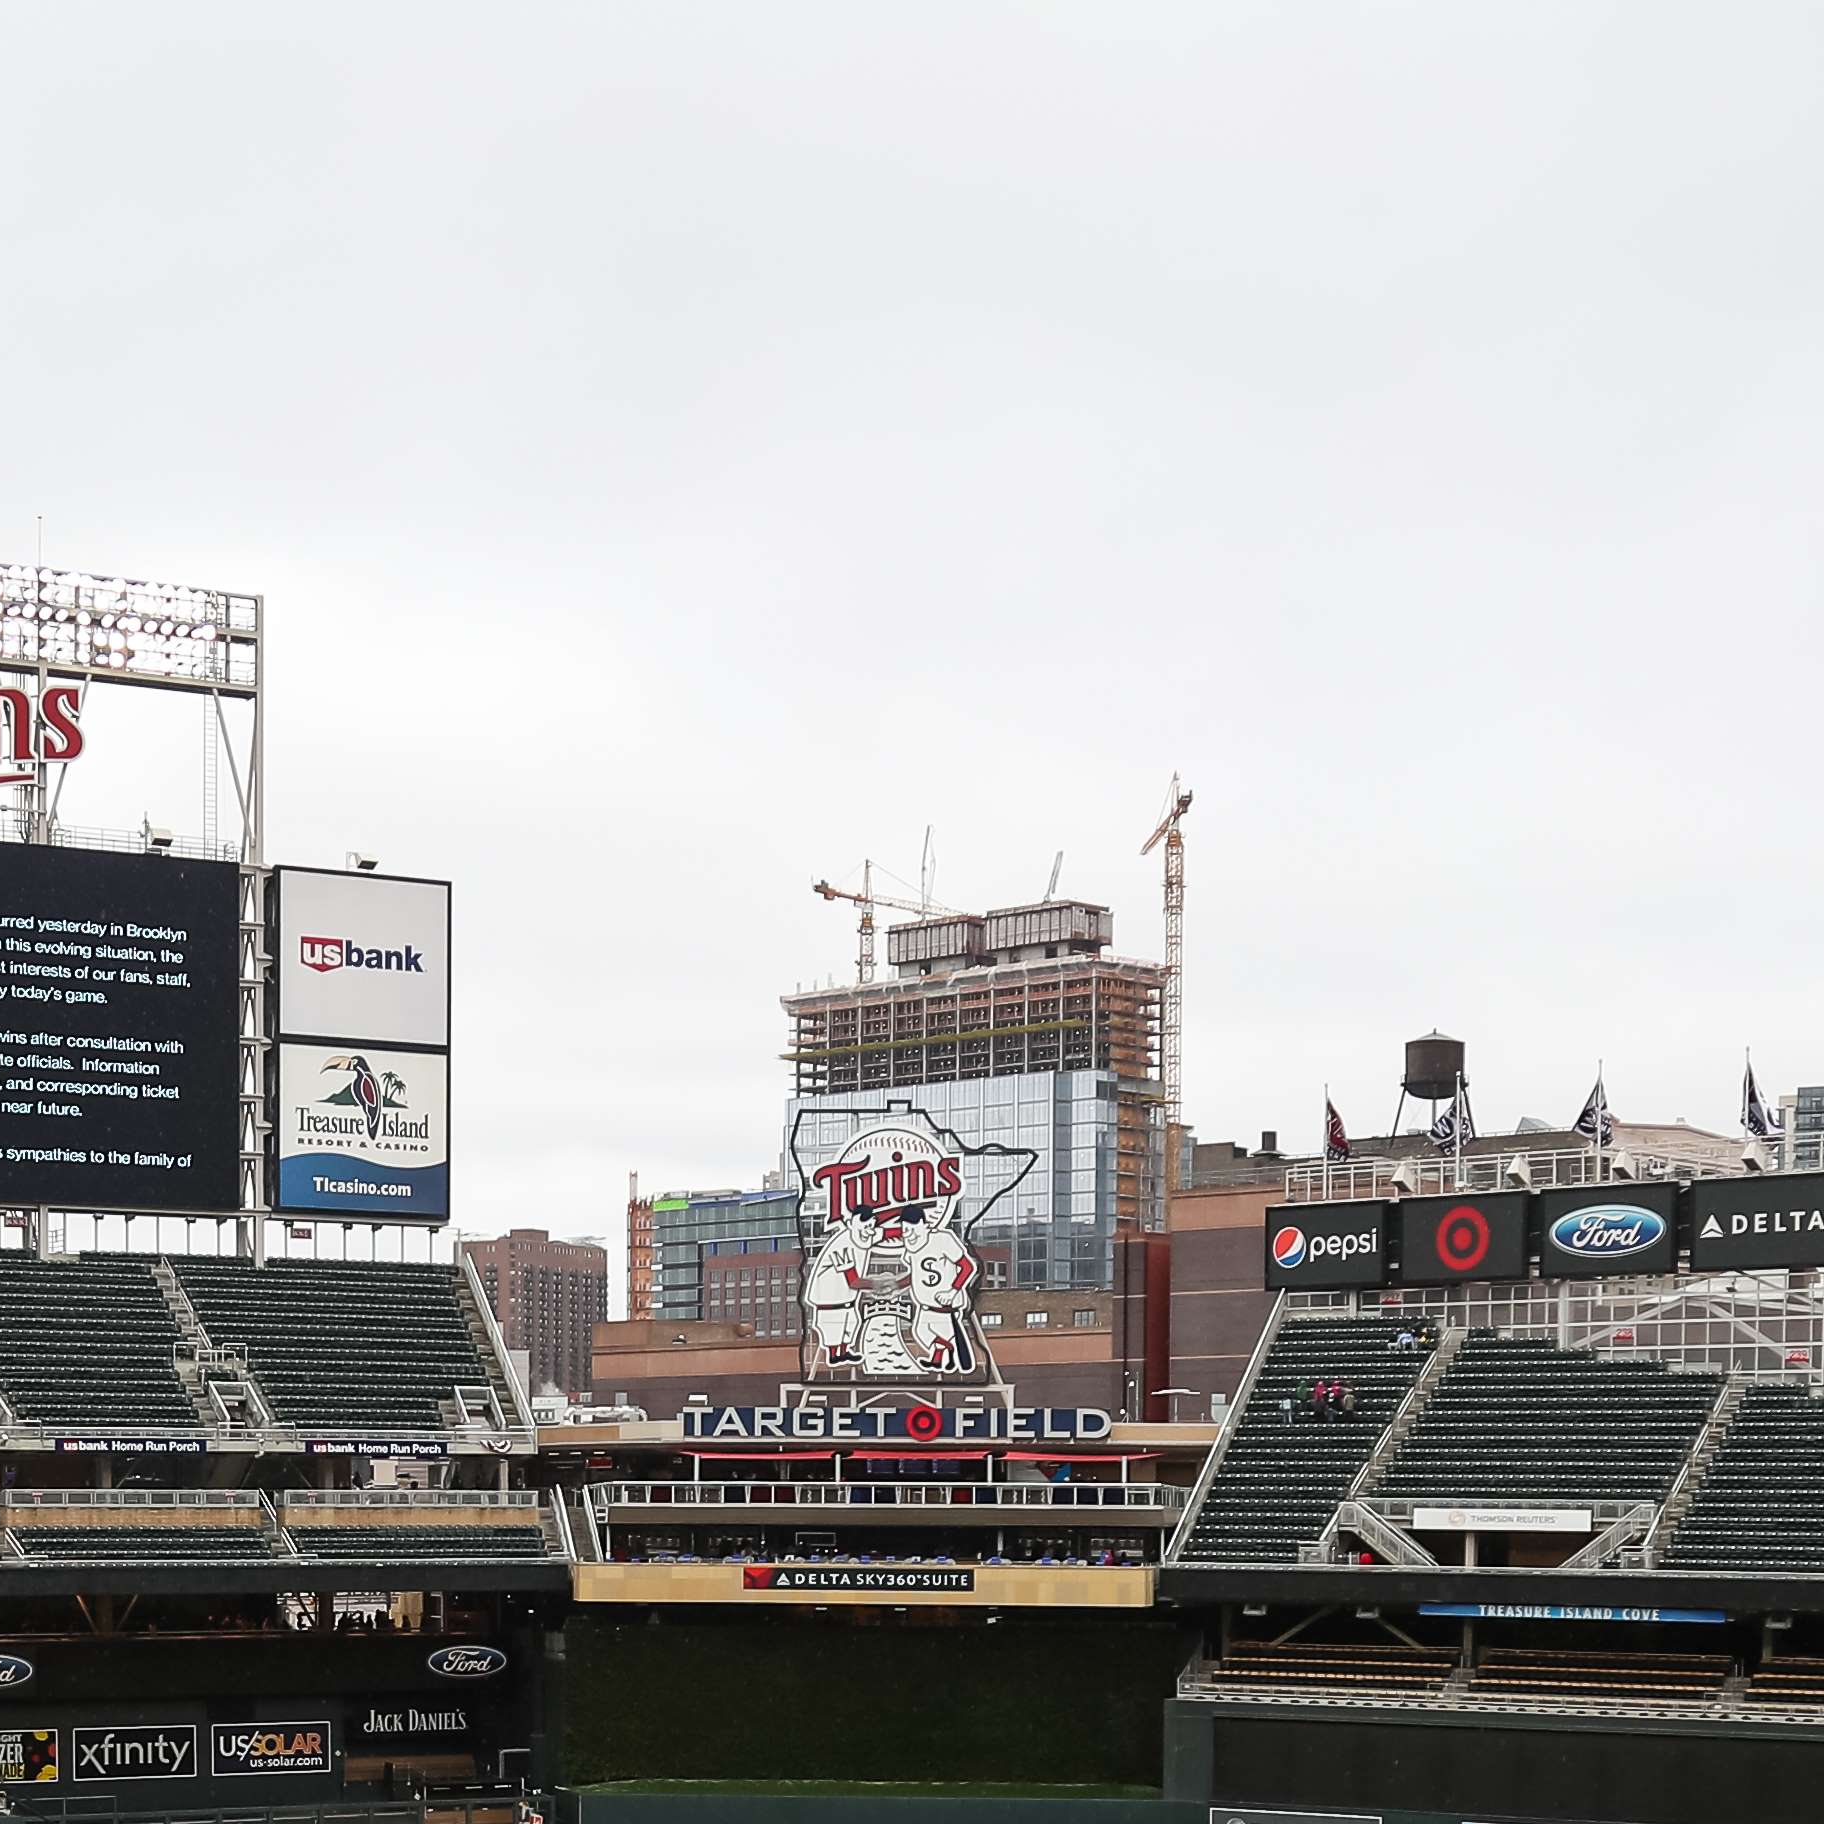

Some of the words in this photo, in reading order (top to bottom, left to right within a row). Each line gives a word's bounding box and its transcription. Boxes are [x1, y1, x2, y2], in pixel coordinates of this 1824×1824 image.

[37, 919, 108, 938] yesterday
[110, 922, 124, 937] in
[126, 923, 187, 943] Brooklyn
[5, 937, 32, 953] this
[34, 941, 92, 960] evolving
[95, 944, 157, 963] situation,
[160, 949, 184, 964] the
[9, 960, 72, 979] interests
[74, 965, 90, 980] of
[92, 969, 117, 981] our
[119, 966, 154, 985] fans,
[156, 972, 191, 988] staff,
[10, 984, 63, 1002] today's
[64, 990, 108, 1004] game.
[295, 1107, 364, 1135] Treasure
[381, 1113, 429, 1139] Island
[298, 1138, 352, 1148] RESORT
[375, 1142, 429, 1152] CASINO
[313, 1176, 412, 1197] TIcasino.com
[813, 1151, 962, 1225] Twins
[1572, 1213, 1643, 1249] Ford
[1310, 1228, 1377, 1263] pepsi
[683, 1406, 897, 1437] TARGET
[955, 1407, 1112, 1438] FIELD
[794, 1572, 850, 1586] DELTA
[922, 1573, 968, 1586] SUITE
[1479, 1604, 1551, 1618] TREASURE
[1560, 1606, 1613, 1619] ISLAND
[1622, 1607, 1660, 1621] COVE
[444, 1650, 491, 1672] Ford
[80, 1733, 190, 1774] xfinity
